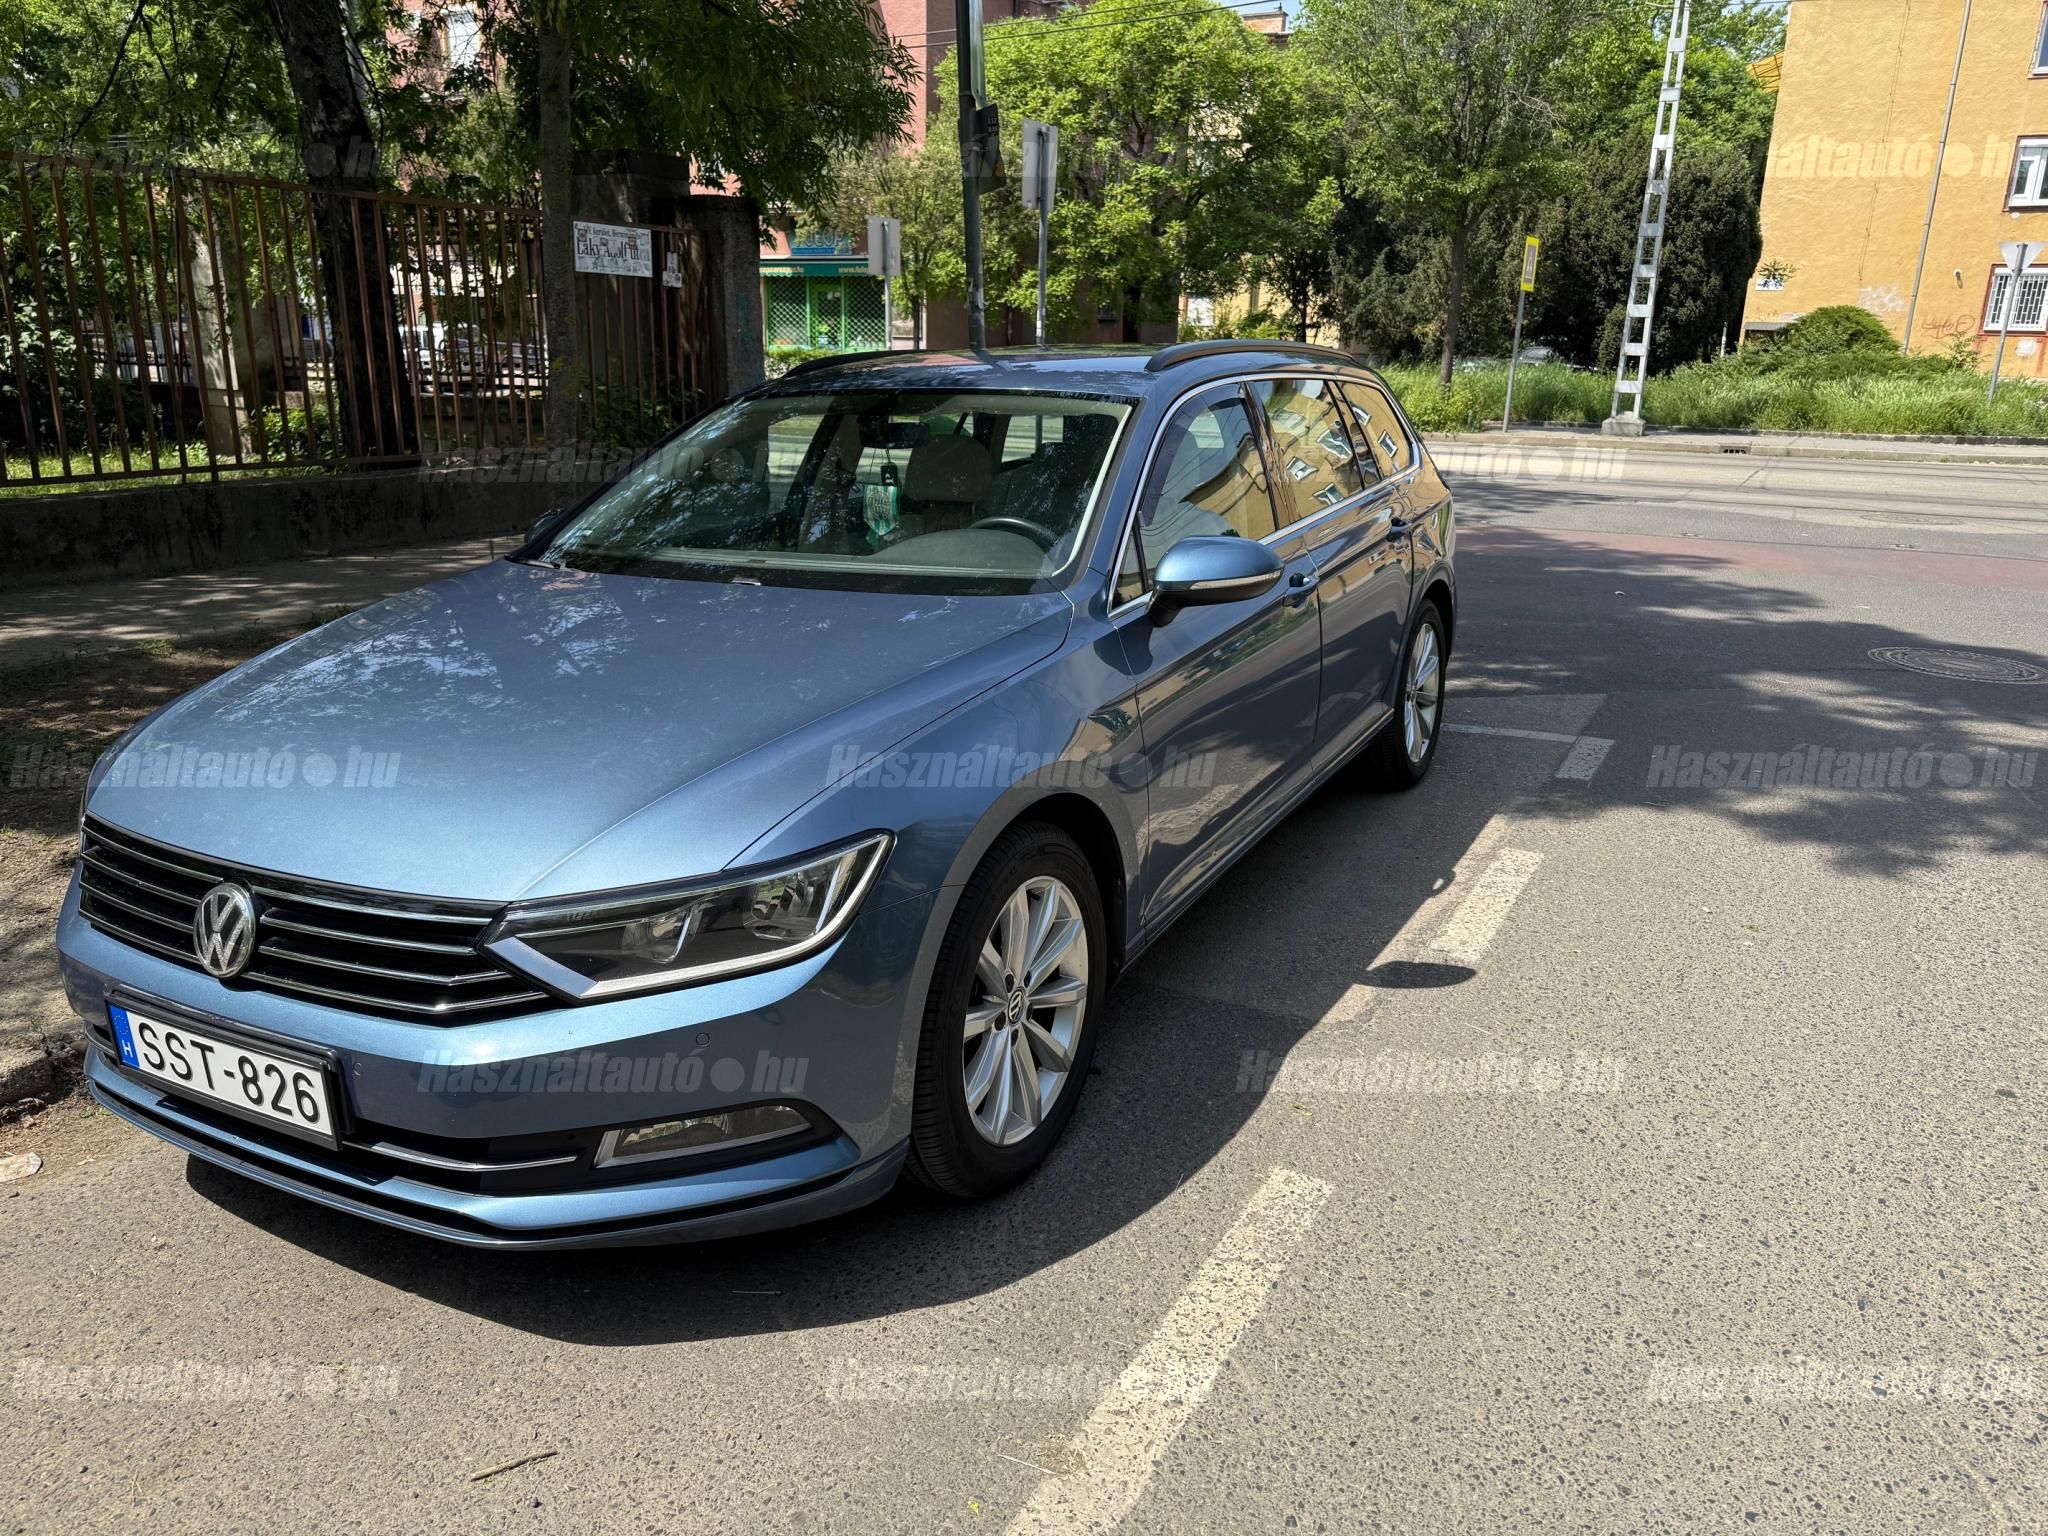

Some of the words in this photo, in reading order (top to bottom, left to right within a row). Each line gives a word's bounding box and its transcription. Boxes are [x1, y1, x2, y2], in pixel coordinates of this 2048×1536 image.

[200, 890, 250, 973] VW
[122, 1040, 134, 1058] H
[137, 1022, 320, 1125] SST-826
